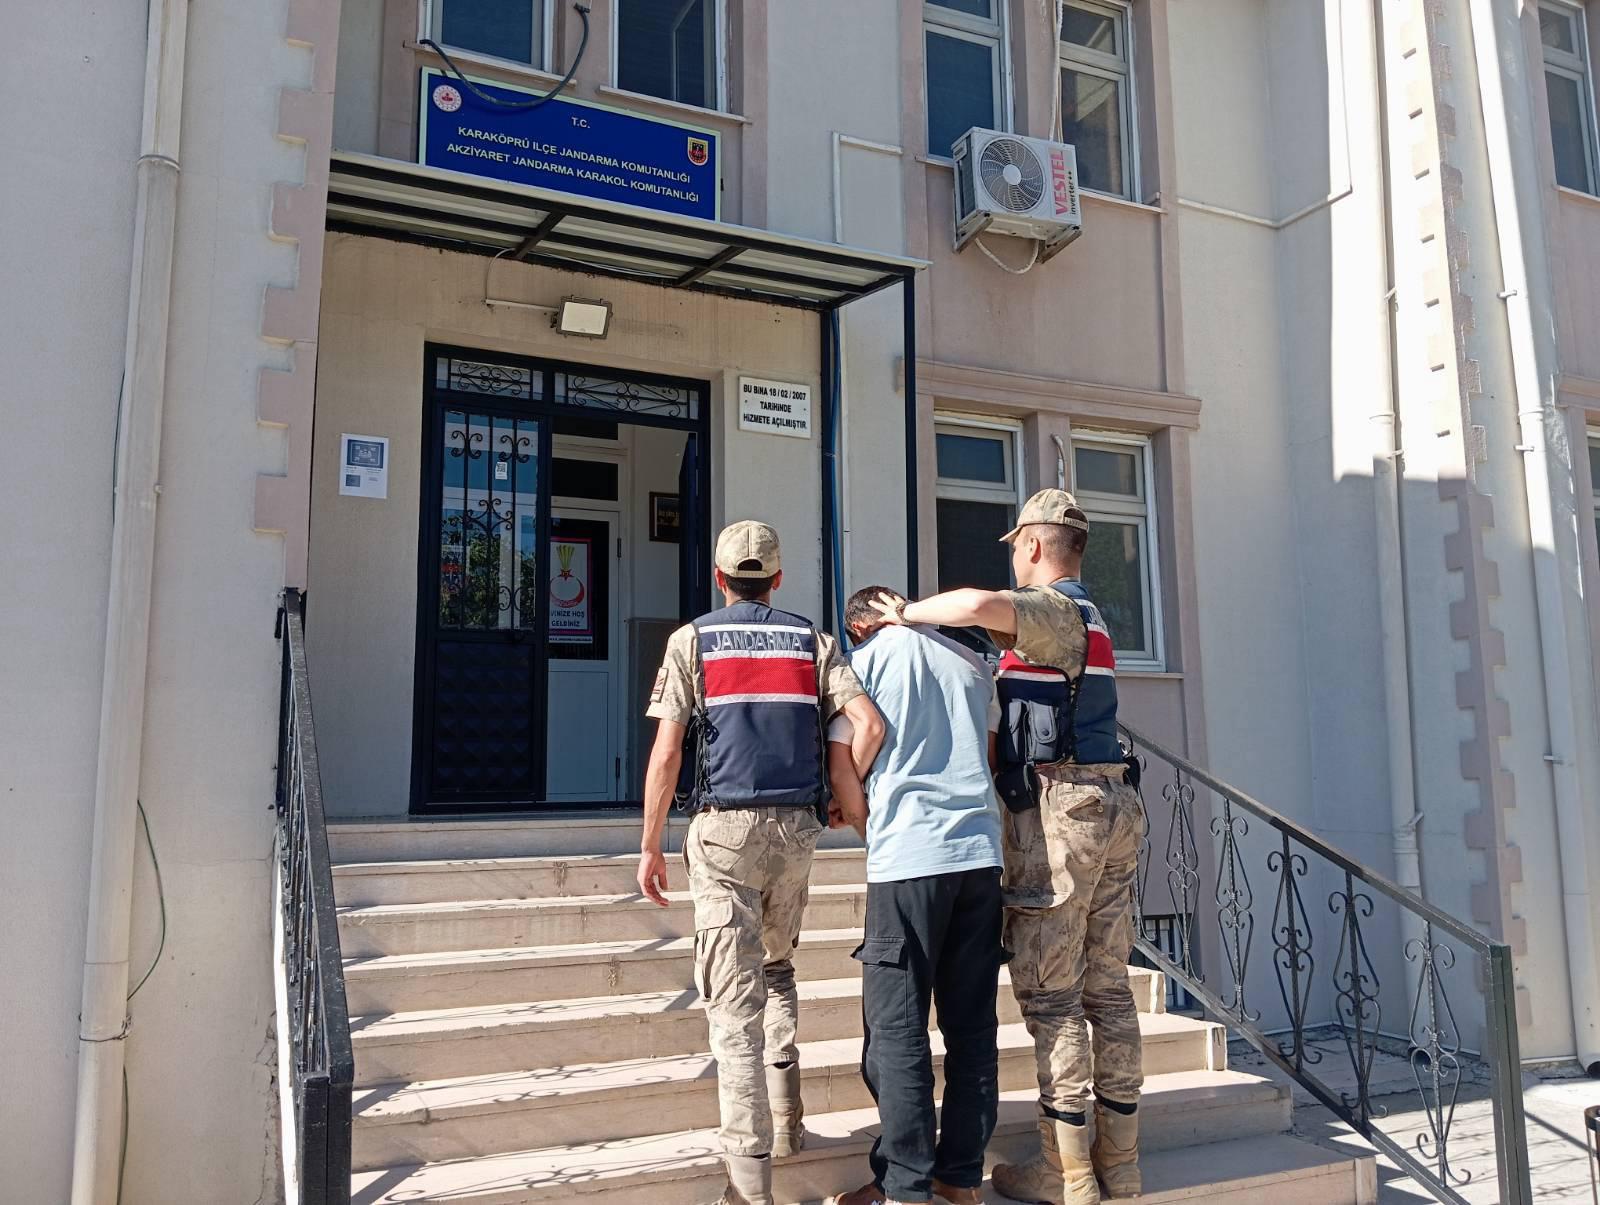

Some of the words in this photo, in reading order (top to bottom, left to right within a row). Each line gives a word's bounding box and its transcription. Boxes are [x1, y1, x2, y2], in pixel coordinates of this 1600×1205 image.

[571, 117, 591, 129] T.C.
[447, 143, 511, 163] AKZİYARET
[512, 156, 574, 176] JANDARMA
[576, 169, 628, 187] KARAKOL
[630, 181, 699, 202] KOMUTANLIĞI
[559, 148, 619, 168] JANDARMA
[621, 161, 690, 183] KOMUTANLIĞI
[1050, 151, 1069, 215] VESTEL
[743, 384, 752, 393] BU
[753, 385, 768, 396] BİNA
[769, 387, 777, 397] 18
[780, 389, 788, 398] 02
[792, 391, 806, 400] 2007
[760, 400, 792, 413] TARİHİNDE
[743, 413, 771, 425] HİZMETE
[711, 631, 803, 652] JANDARMA
